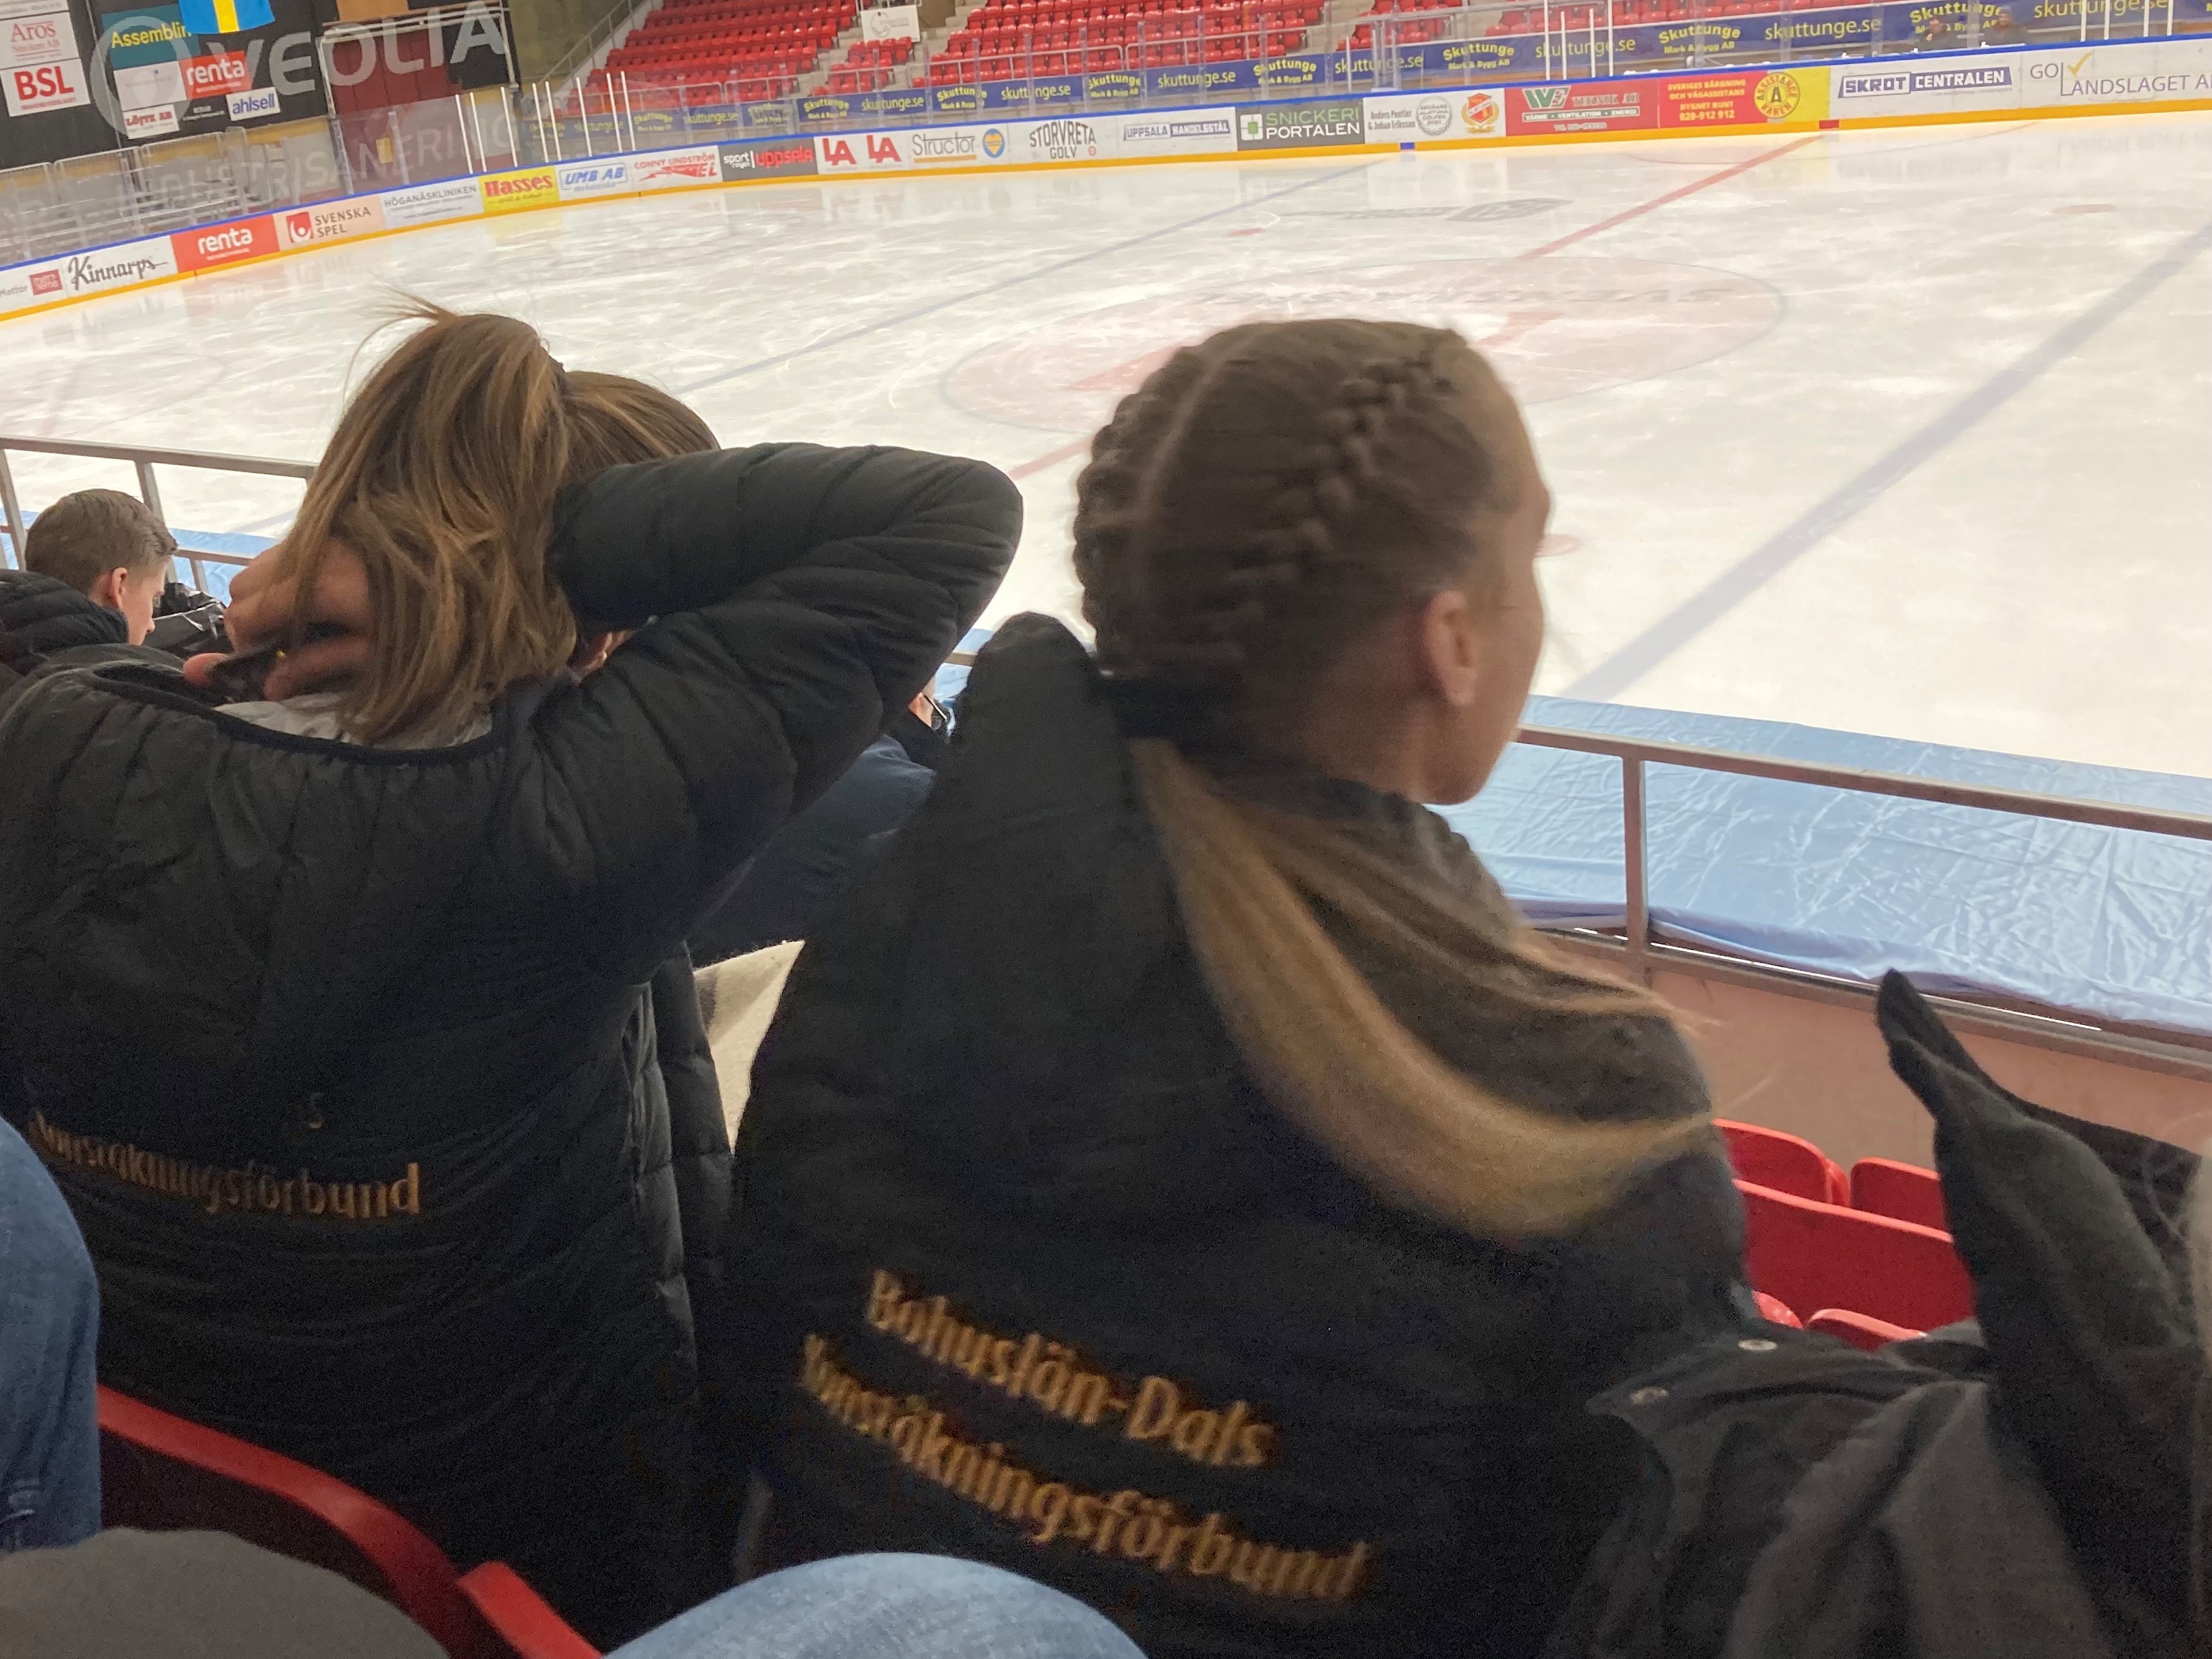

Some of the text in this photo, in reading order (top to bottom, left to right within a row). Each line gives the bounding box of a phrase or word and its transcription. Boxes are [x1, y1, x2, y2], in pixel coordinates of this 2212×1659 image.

[11, 22, 56, 42] Aros
[1765, 18, 1882, 40] skuttunge.se
[187, 59, 245, 86] renta
[1158, 70, 1235, 88] skuttunge.se
[1846, 70, 2004, 93] SKROT CENTRALEN
[2196, 74, 2212, 89] A
[14, 66, 74, 101] BSL
[1001, 84, 1071, 100] skuttnge.se
[232, 93, 275, 114] ahlsell
[1266, 107, 1360, 125] SNICKERI
[1558, 111, 1601, 119] VENTILATION
[1718, 110, 1735, 118] 912
[1030, 121, 1096, 148] STORVRETA
[1127, 126, 1168, 137] UPPSALA
[1266, 122, 1360, 140] PORTALEN
[913, 131, 975, 155] Structor
[668, 153, 715, 165] LINDSTRÖM
[723, 152, 750, 165] sport
[1049, 146, 1077, 159] GOLV
[565, 167, 624, 185] UMB AB
[484, 175, 554, 198] Hasses
[315, 206, 371, 225] SVENSKA
[316, 224, 347, 238] SPEL
[198, 227, 253, 255] renta
[68, 256, 168, 290] Kinnarps
